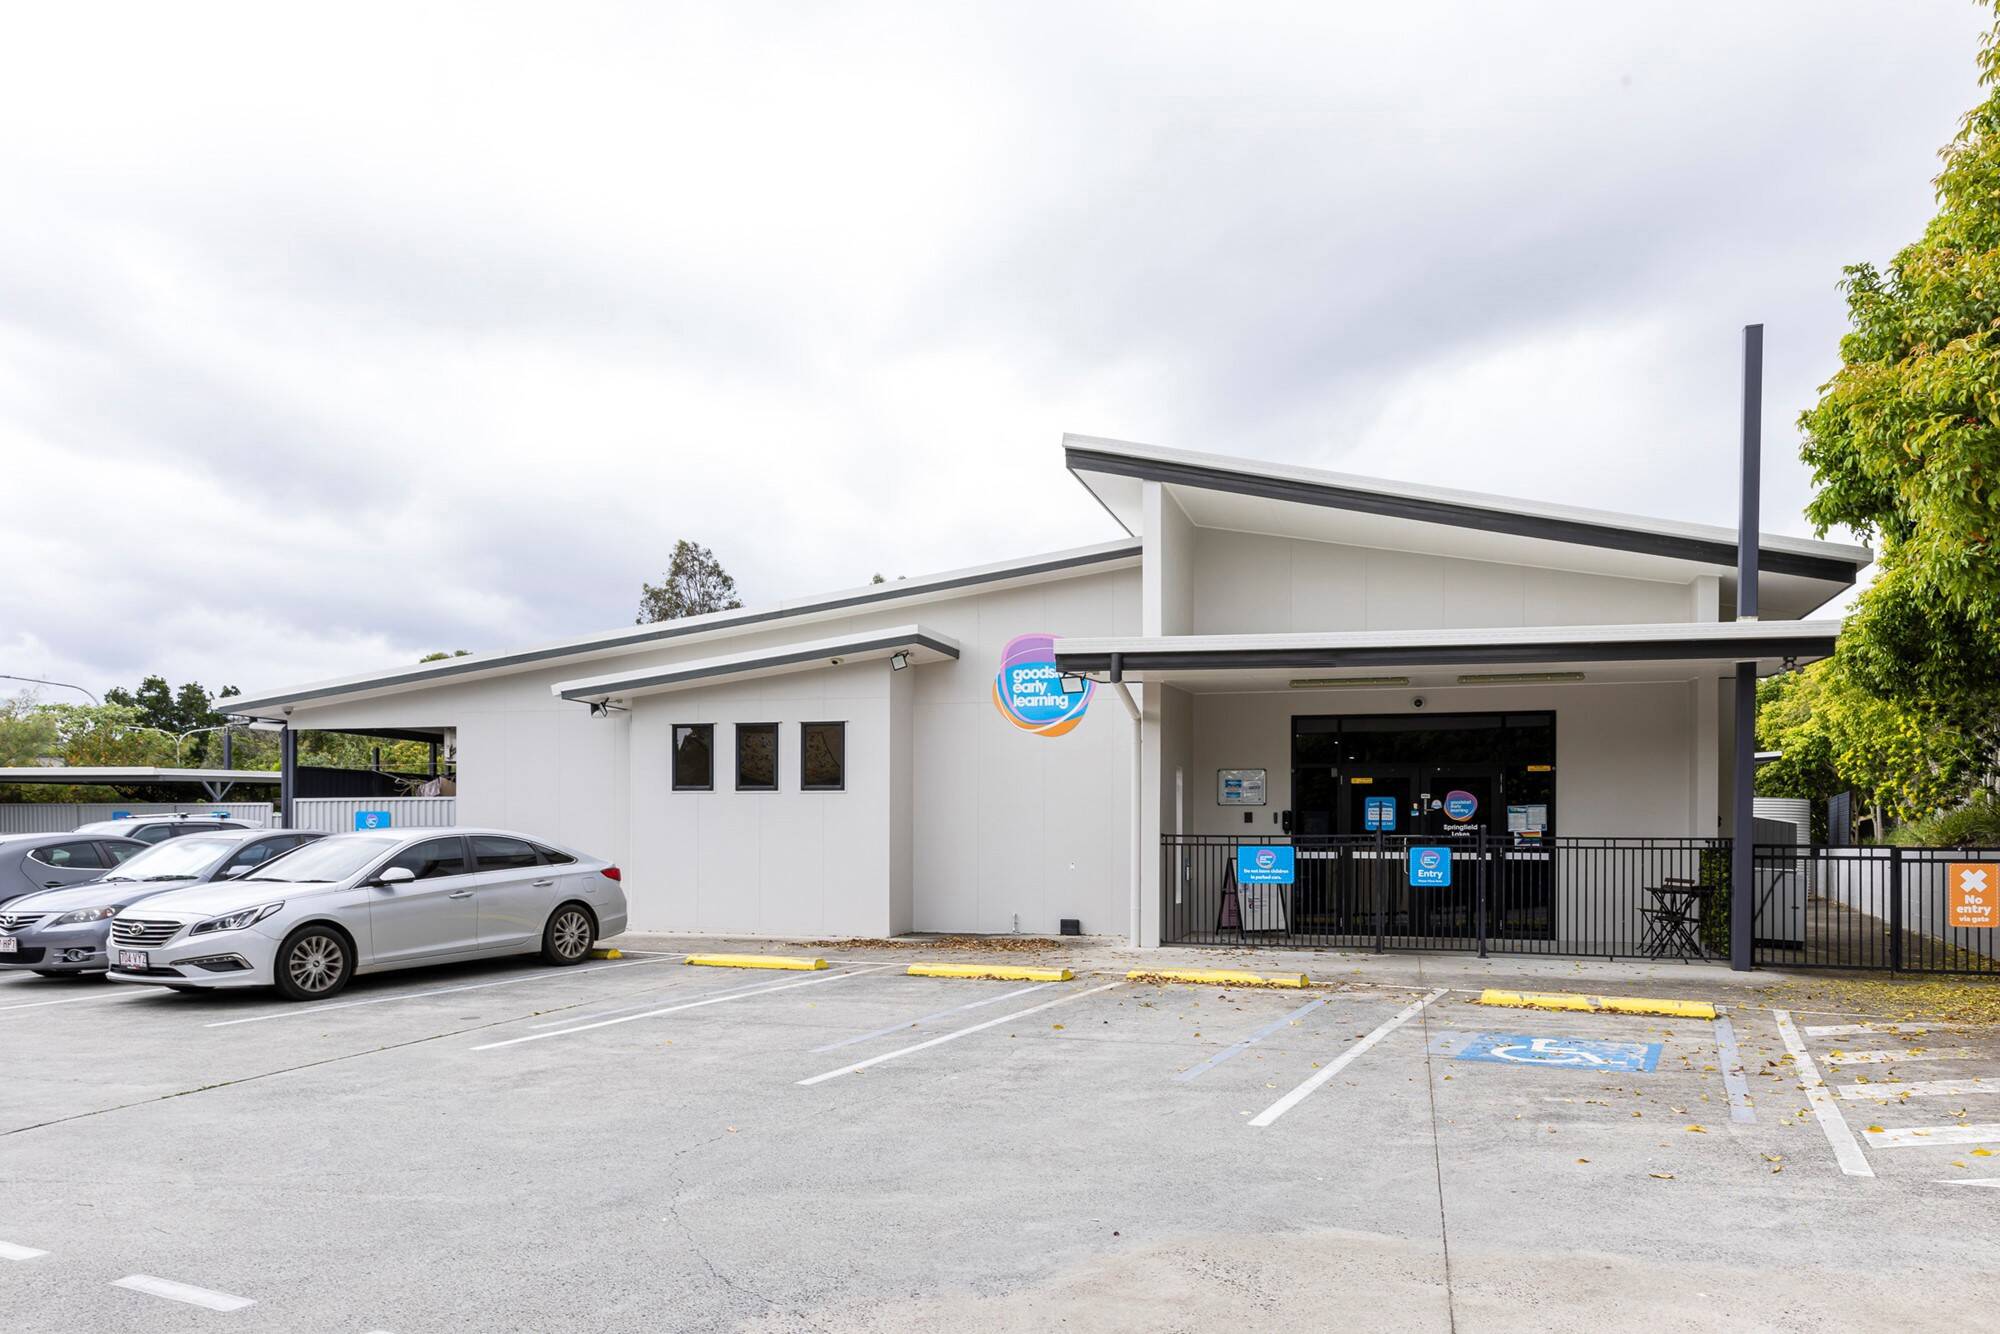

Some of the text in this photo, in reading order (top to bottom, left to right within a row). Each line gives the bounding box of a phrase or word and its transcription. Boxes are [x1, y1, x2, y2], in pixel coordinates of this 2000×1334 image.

[1012, 680, 1048, 695] early
[1013, 693, 1068, 709] learning
[1418, 870, 1443, 879] Entry
[1965, 895, 1983, 904] No
[1956, 905, 1992, 916] entry
